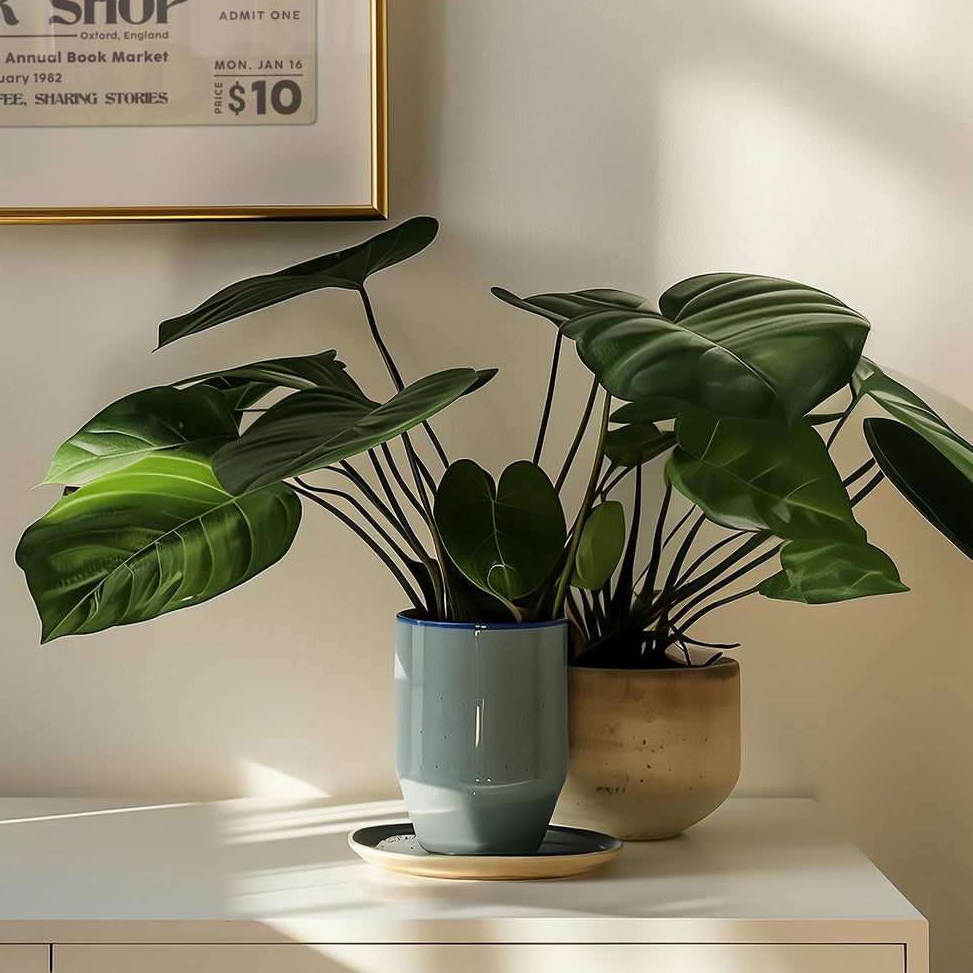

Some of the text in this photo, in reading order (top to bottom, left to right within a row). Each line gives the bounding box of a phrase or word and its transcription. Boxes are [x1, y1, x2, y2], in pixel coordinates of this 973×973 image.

[219, 10, 301, 21] ADMIT ONE
[80, 30, 169, 41] Oxford, England
[5, 52, 61, 63] Annual
[67, 51, 107, 63] Book
[112, 51, 169, 62] Market
[215, 59, 303, 70] MON. JAN 16
[33, 73, 62, 83] 1982
[35, 93, 97, 105] SHARING
[105, 92, 168, 105] STORIES
[214, 82, 223, 114] PRICE
[228, 79, 302, 116] $10
